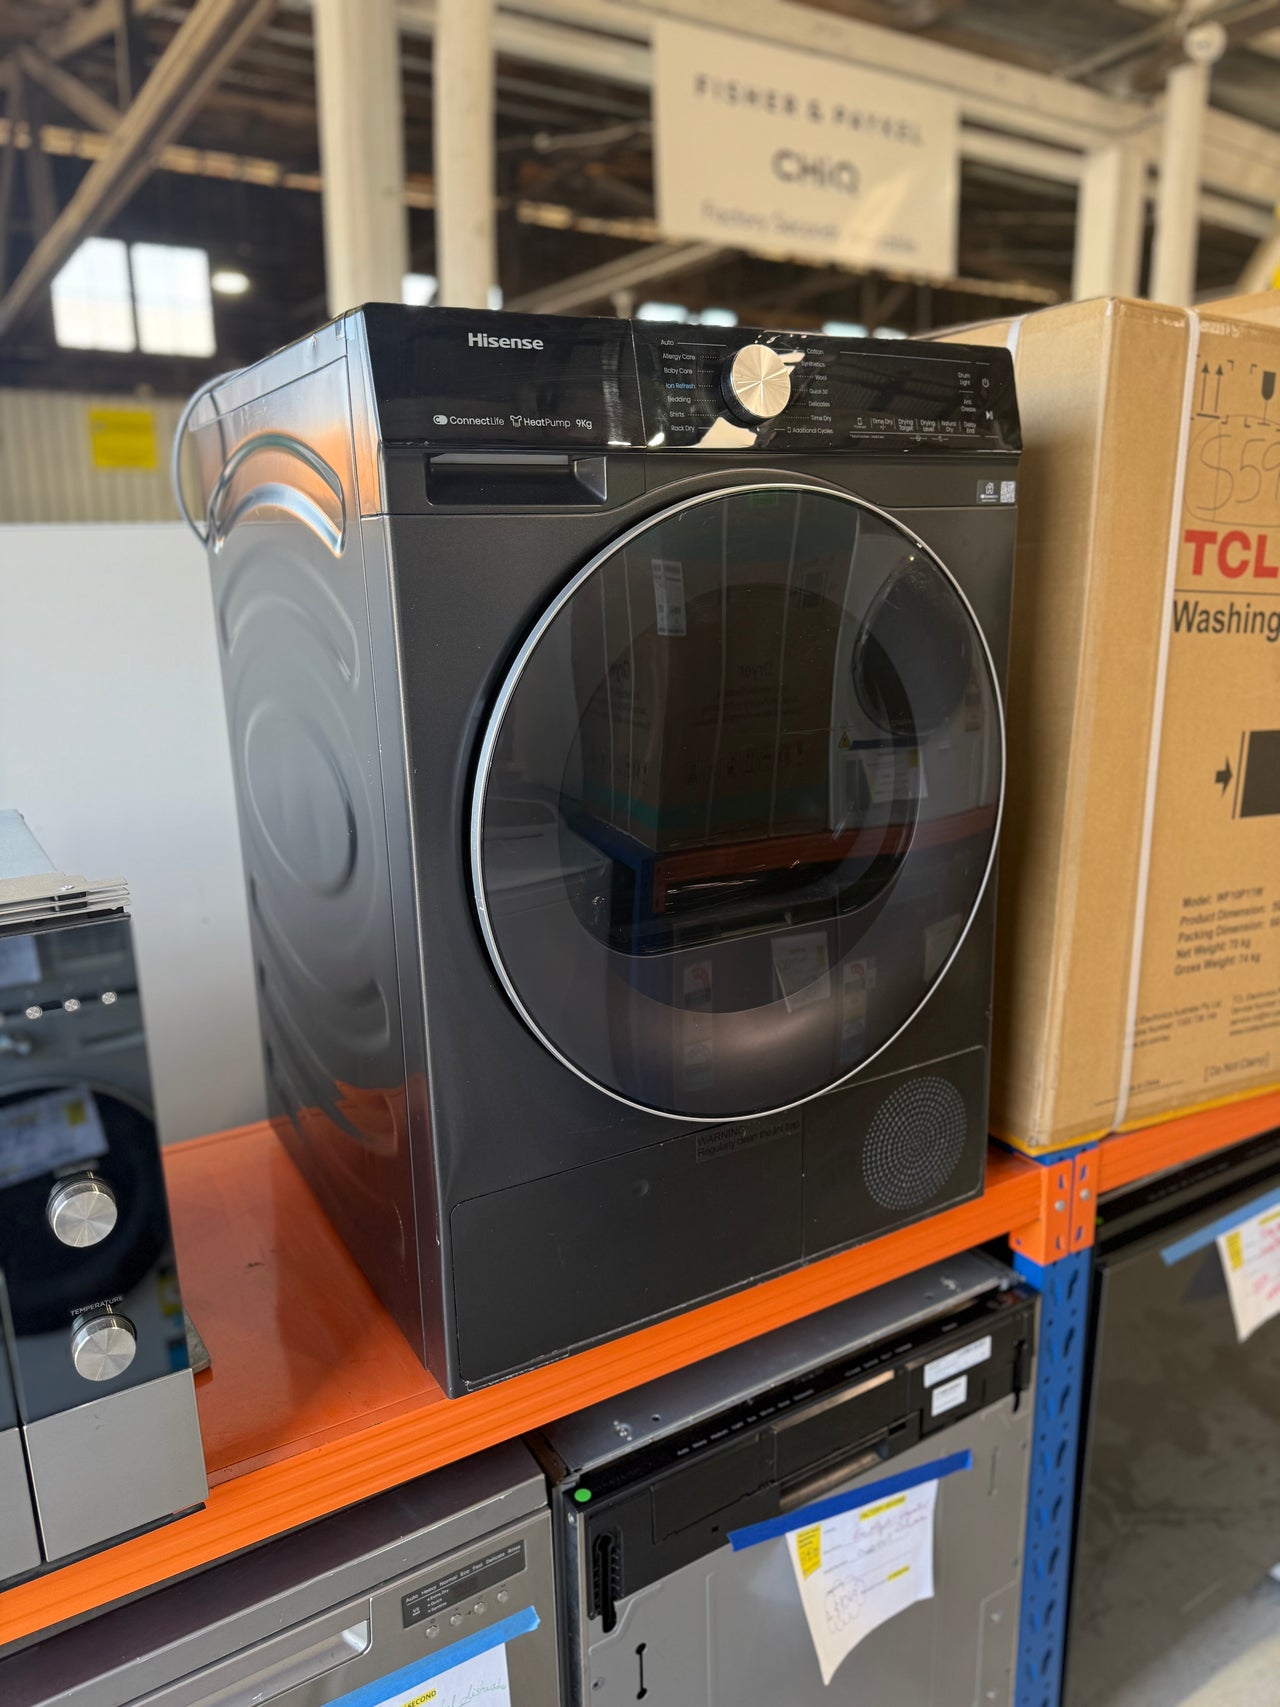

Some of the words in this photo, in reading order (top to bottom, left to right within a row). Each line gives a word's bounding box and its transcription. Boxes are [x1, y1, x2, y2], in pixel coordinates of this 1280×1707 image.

[694, 73, 797, 116] FISHER
[807, 98, 822, 123] &
[833, 104, 923, 147] PAYKEL
[467, 332, 544, 350] Hisense
[666, 382, 675, 390] Ion
[668, 396, 691, 404] Bedding
[449, 414, 506, 427] ConnectLife
[524, 416, 572, 430] HeatPump
[576, 418, 594, 430] 9Kg
[884, 418, 894, 426] Dry
[898, 418, 914, 426] Drying
[920, 419, 936, 428] Drying
[1184, 529, 1280, 579] TCL
[1173, 599, 1280, 642] Washing
[1180, 911, 1215, 926] Product
[1178, 928, 1213, 943] Packing
[1176, 948, 1192, 960] Net
[1174, 962, 1200, 976] Gross
[70, 1296, 124, 1316] TEMPERATURE
[406, 1594, 419, 1603] Auto
[421, 1584, 438, 1596] Heavy
[440, 1574, 458, 1587] Normal
[460, 1569, 470, 1577] Eco
[472, 1562, 483, 1572] Fast
[486, 1552, 506, 1565] Delicate
[407, 1690, 437, 1707] SECOND
